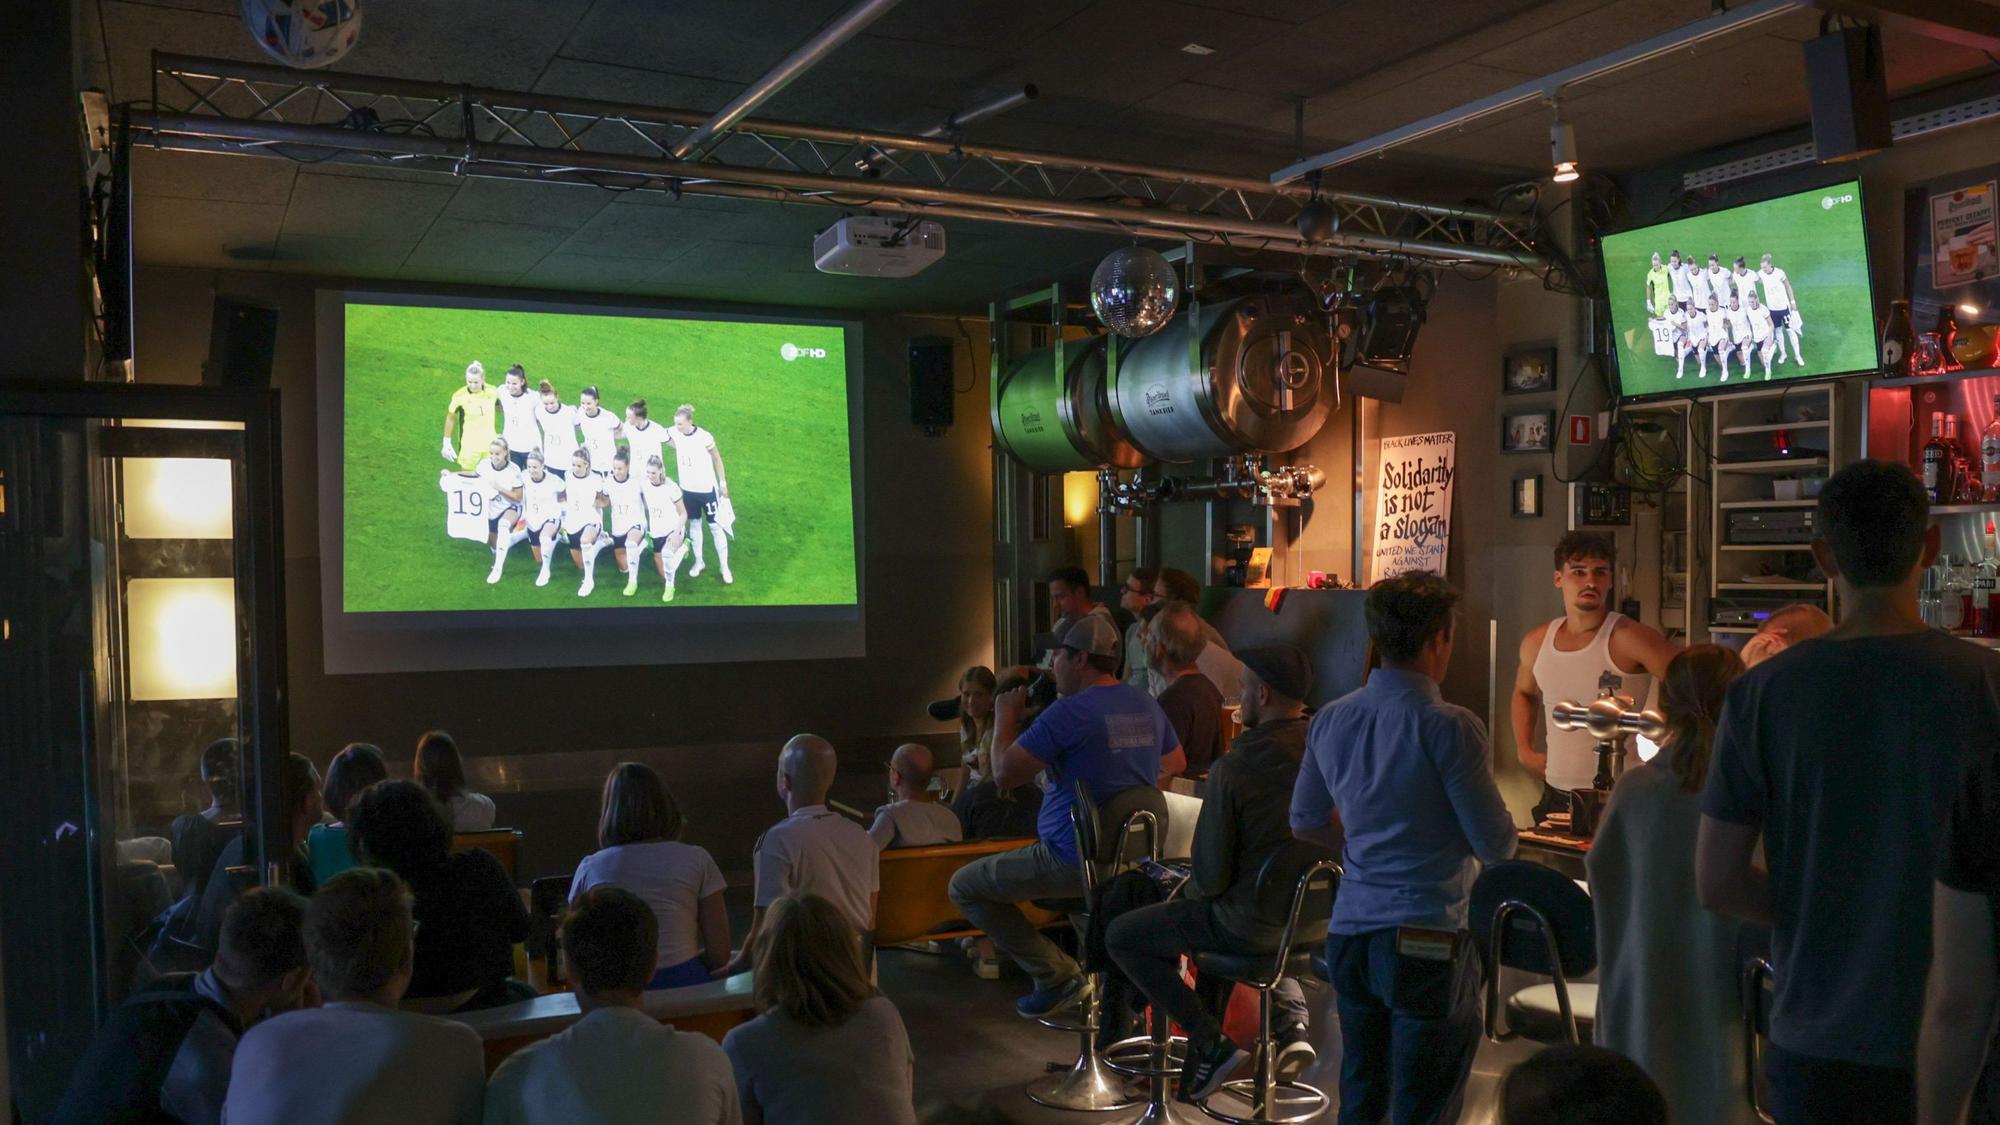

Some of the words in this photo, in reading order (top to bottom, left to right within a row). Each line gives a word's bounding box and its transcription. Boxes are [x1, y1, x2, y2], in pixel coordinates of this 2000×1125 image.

[1655, 327, 1670, 342] 19
[810, 348, 826, 358] HD
[1383, 438, 1404, 450] BLACK
[1404, 436, 1424, 447] LIVES
[1424, 434, 1454, 446] MATTER
[1383, 456, 1454, 491] Solidarity
[453, 489, 483, 517] 19
[1384, 493, 1398, 517] is
[1401, 487, 1435, 513] not
[1380, 521, 1391, 540] a
[1393, 514, 1449, 548] slogan
[1376, 546, 1403, 557] UNITED
[1404, 545, 1417, 556] WE
[1418, 543, 1446, 556] STAND
[1392, 556, 1431, 567] AGAINST
